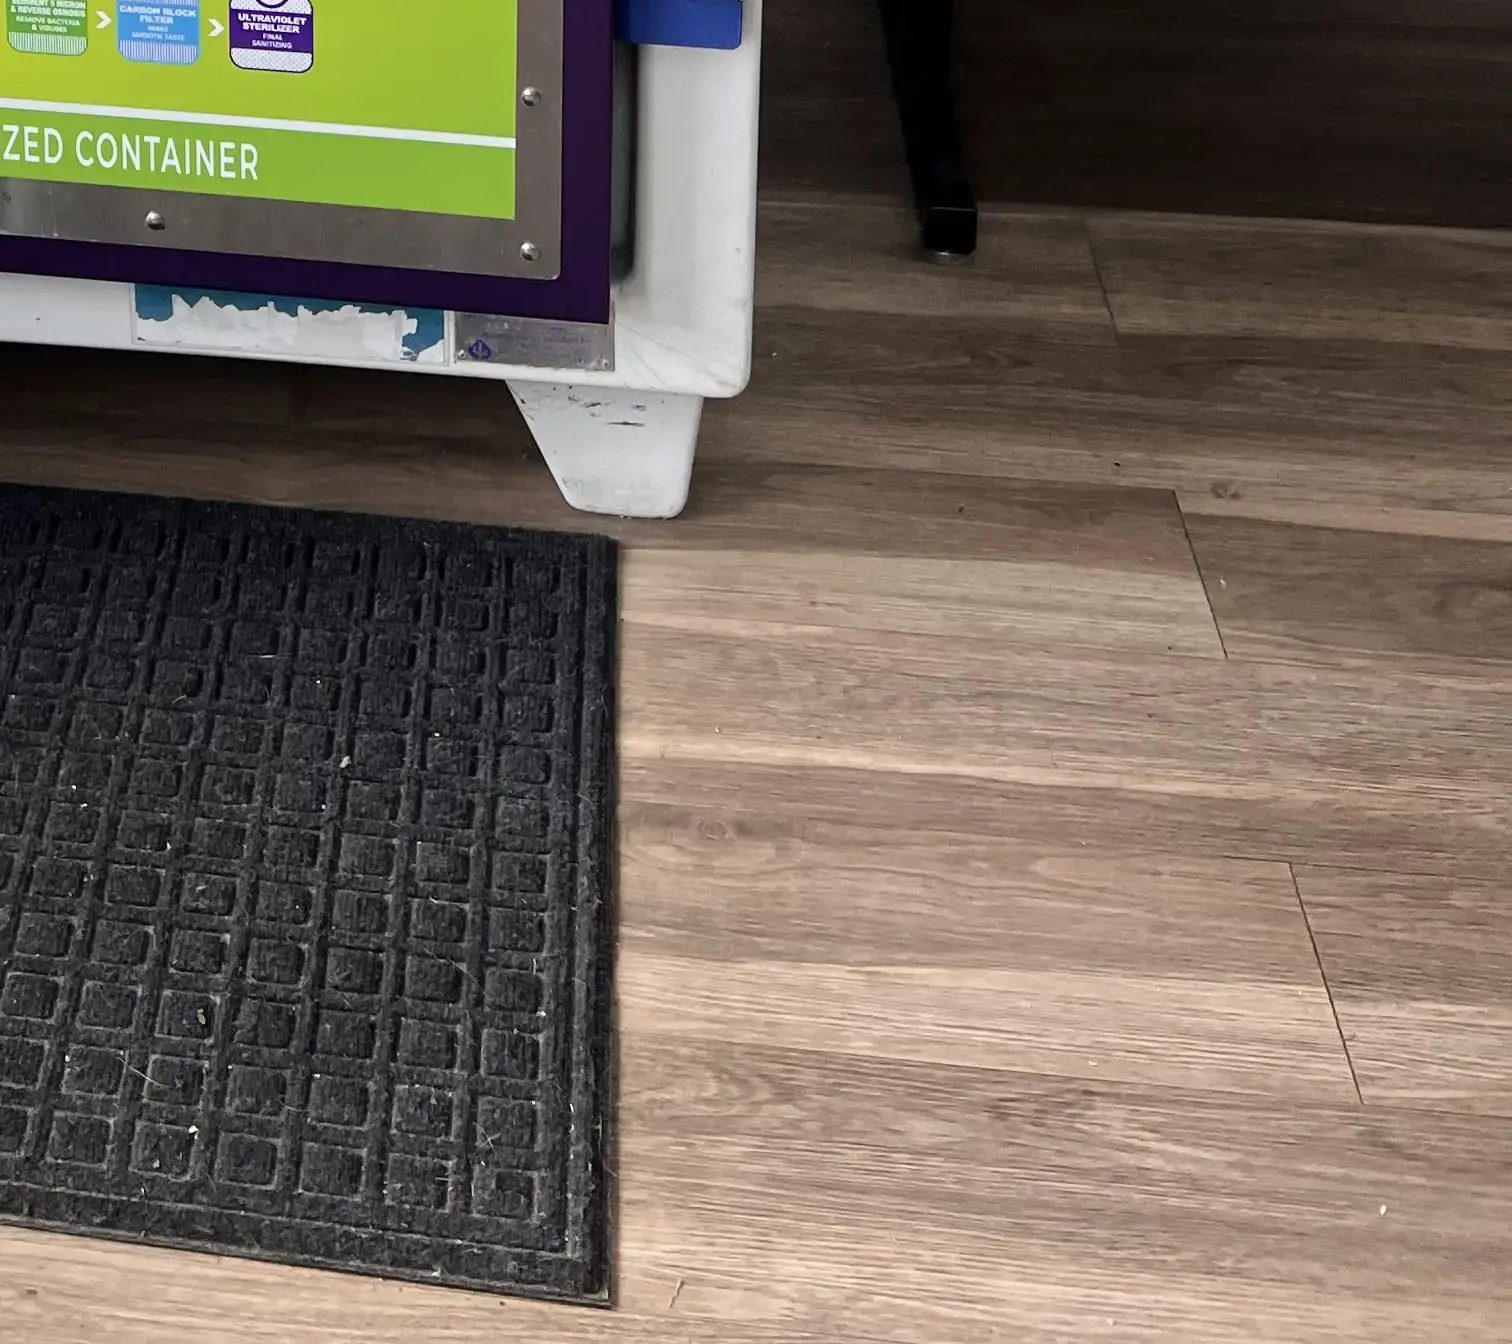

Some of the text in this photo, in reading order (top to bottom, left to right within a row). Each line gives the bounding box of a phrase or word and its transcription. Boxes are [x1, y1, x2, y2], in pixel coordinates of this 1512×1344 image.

[18, 5, 51, 16] REVERSE
[52, 8, 86, 18] OSMOSIS
[119, 4, 196, 18] CARBON BLOCK
[139, 14, 174, 25] FILTER
[237, 12, 307, 26] ULTRAVIOLET
[242, 21, 300, 34] STERILIZER
[262, 32, 284, 41] FINAL
[251, 39, 293, 49] SANITIZING
[75, 129, 259, 181] CONTAINER
